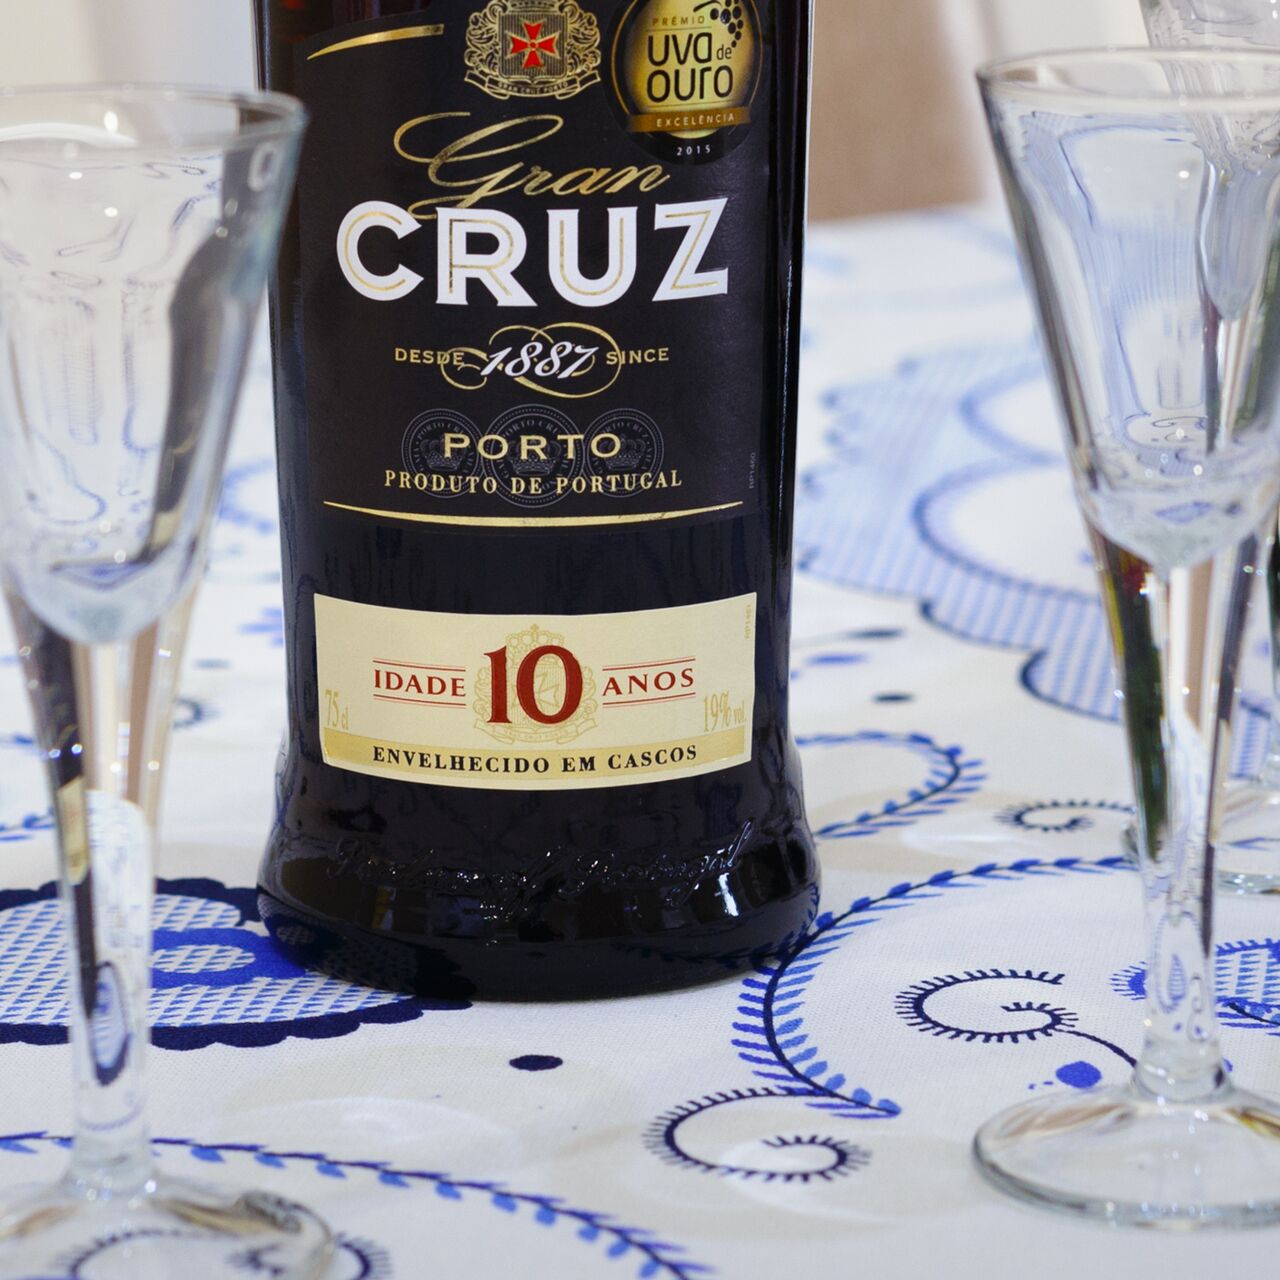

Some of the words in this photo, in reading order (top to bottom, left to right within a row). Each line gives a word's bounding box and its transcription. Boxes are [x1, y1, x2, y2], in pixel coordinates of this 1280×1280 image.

[716, 44, 733, 61] de
[656, 112, 735, 128] EXCELÊNCIA
[393, 111, 671, 220] Gran
[676, 144, 711, 157] 2015
[336, 197, 729, 308] CRUZ
[394, 346, 466, 368] DESDE
[480, 339, 600, 380] 1887
[606, 346, 670, 367] SINCE
[443, 432, 622, 461] PORTO
[384, 469, 498, 495] PRODUTO
[510, 476, 542, 495] DE
[555, 468, 683, 496] PORTUGAL
[373, 668, 467, 698] IDADE
[483, 643, 584, 726] 10
[601, 667, 695, 697] ANOS
[324, 688, 340, 728] 75
[703, 688, 732, 733] 19%
[372, 746, 550, 775] ENVELHECIDO
[561, 755, 597, 774] EM
[607, 744, 698, 770] CASCOS
